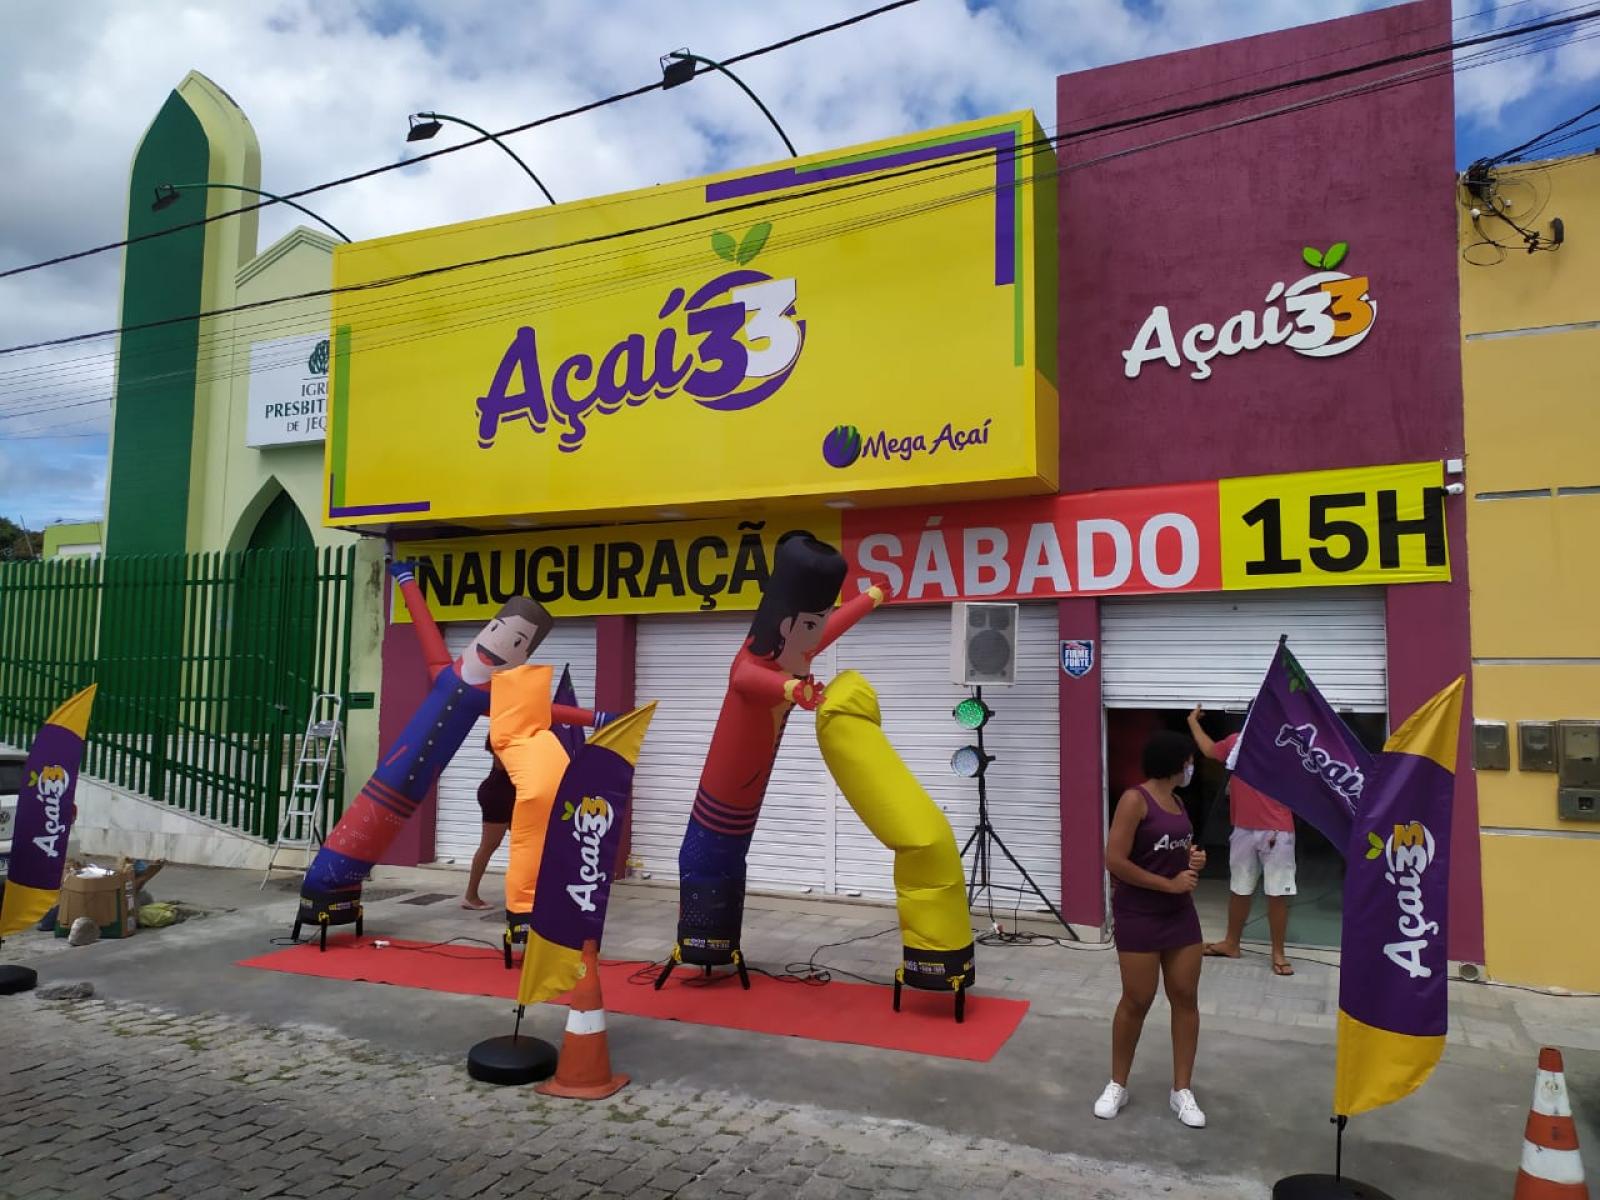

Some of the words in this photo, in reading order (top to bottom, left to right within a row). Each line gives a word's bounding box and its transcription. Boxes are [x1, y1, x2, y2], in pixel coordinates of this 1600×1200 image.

[265, 398, 328, 419] PRESBIT
[287, 420, 300, 432] DE
[861, 430, 927, 461] Mega
[928, 418, 992, 455] Açaí
[857, 512, 1201, 599] SÁBADO
[1241, 486, 1446, 577] 15H
